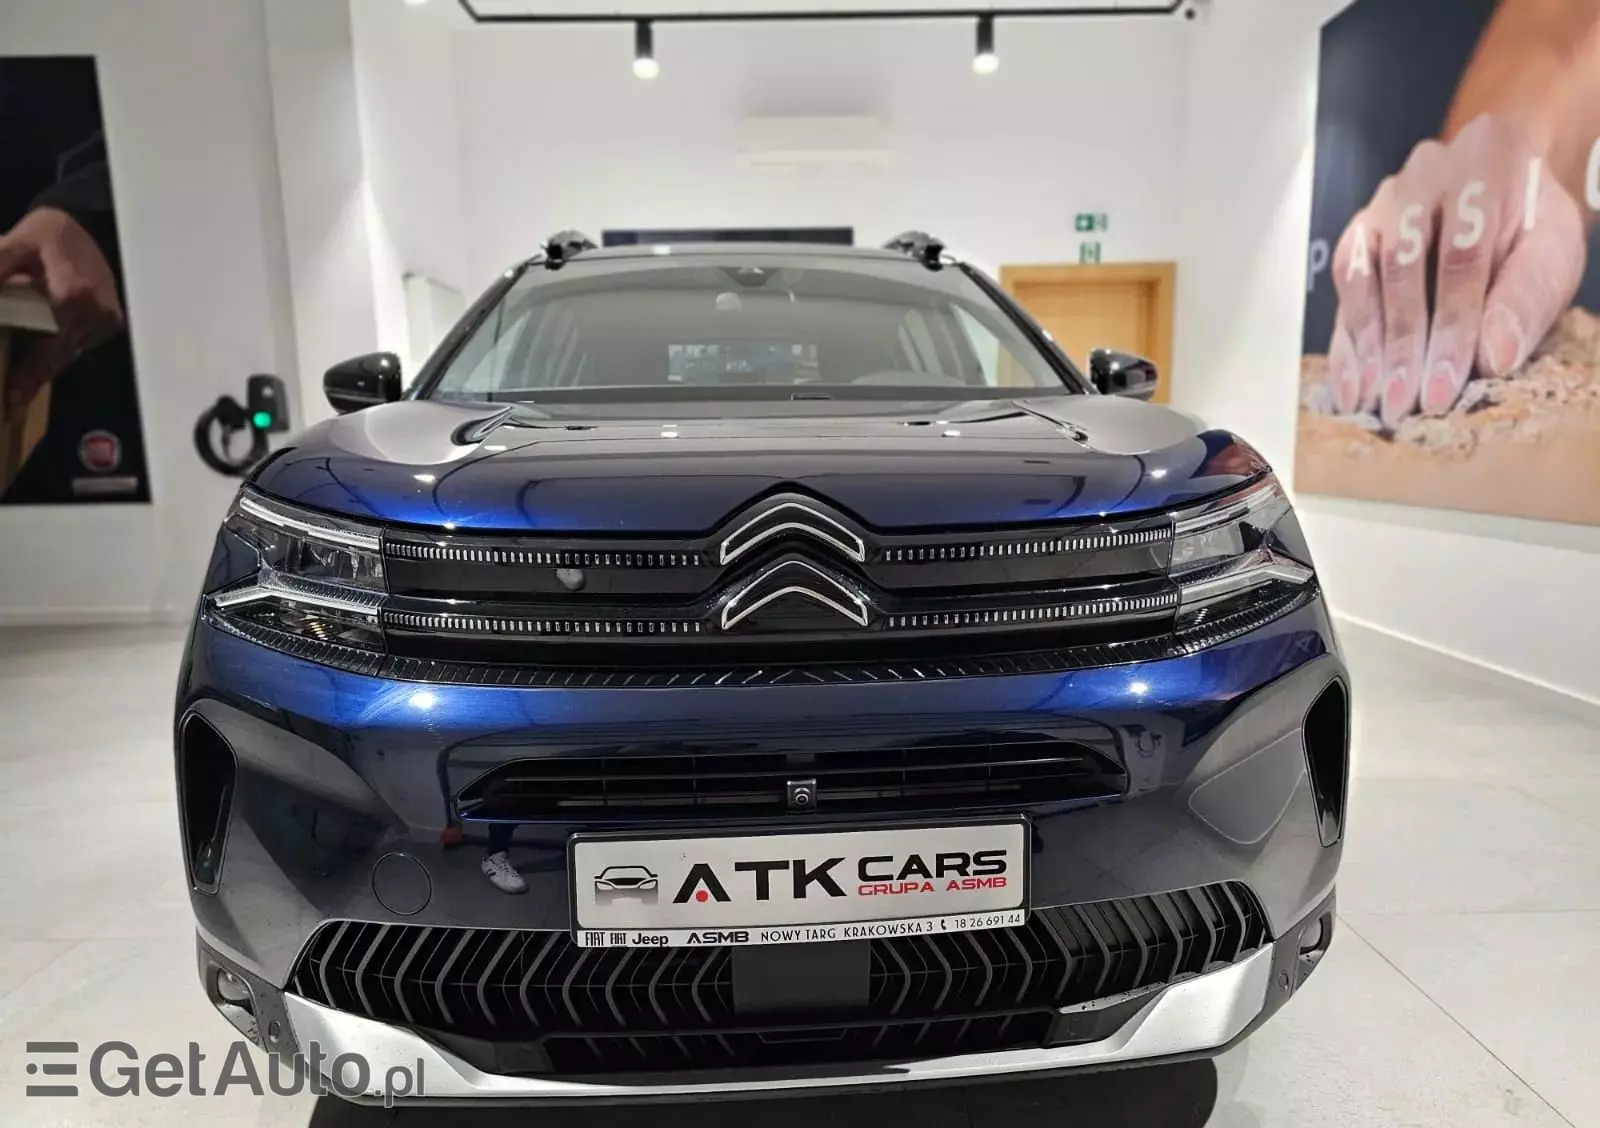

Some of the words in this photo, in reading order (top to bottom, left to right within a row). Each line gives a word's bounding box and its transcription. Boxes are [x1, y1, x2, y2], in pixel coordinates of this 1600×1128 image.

[672, 857, 847, 904] ATK
[858, 850, 1007, 881] CARS
[858, 879, 935, 896] GRUPA
[945, 876, 1007, 892] ASMB
[585, 932, 605, 947] FIAT
[632, 933, 669, 947] Jeep
[686, 931, 749, 945] ASMB
[761, 930, 800, 942] NOWY
[805, 928, 836, 940] TARG
[844, 922, 923, 937] KRAKOWSKA
[926, 921, 933, 932] 3
[955, 918, 966, 929] 18
[969, 916, 983, 928] 26
[986, 914, 1004, 926] 691
[1007, 913, 1021, 924] 44
